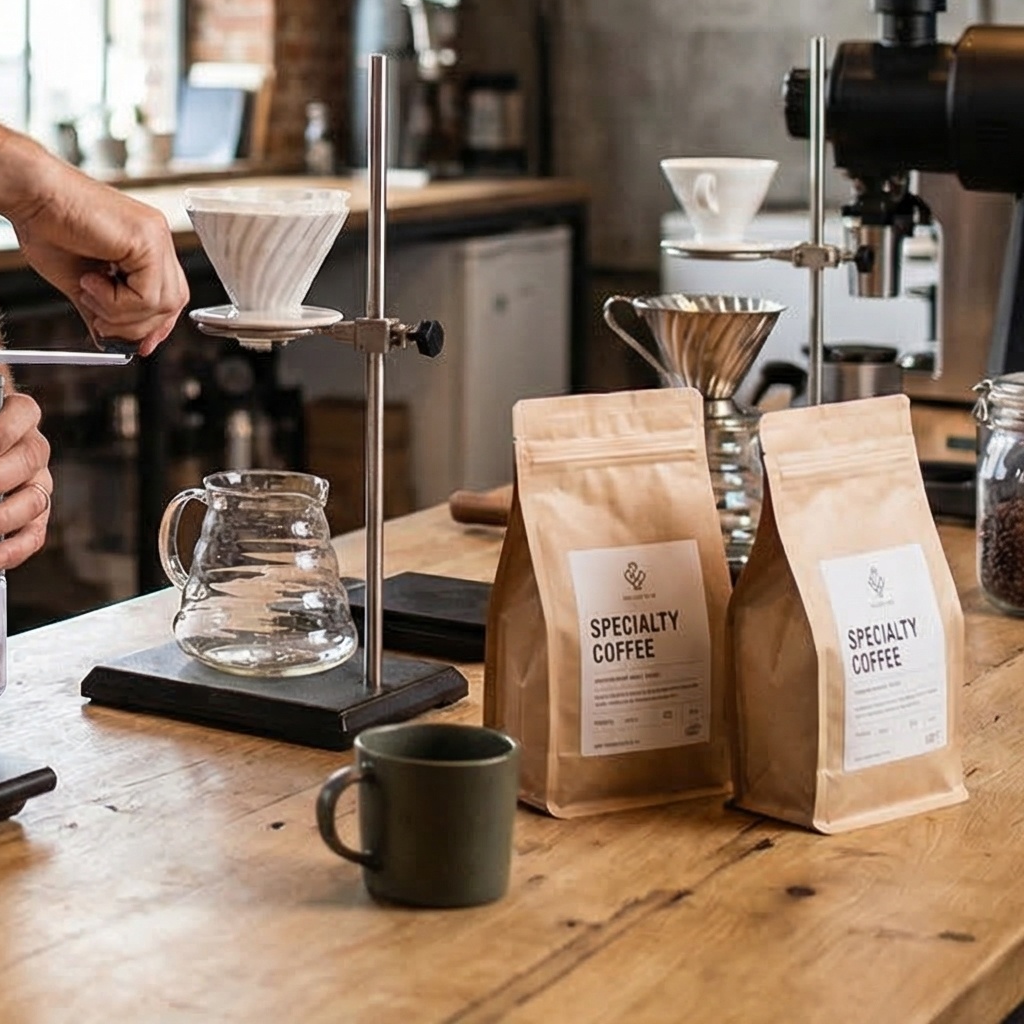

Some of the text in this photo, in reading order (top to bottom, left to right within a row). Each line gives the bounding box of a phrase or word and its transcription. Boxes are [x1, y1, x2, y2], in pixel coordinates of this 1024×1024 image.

[590, 610, 679, 639] SPECIALTY
[847, 617, 918, 650] SPECIALTY
[593, 639, 655, 664] COFFEE
[852, 646, 902, 675] COFFEE
